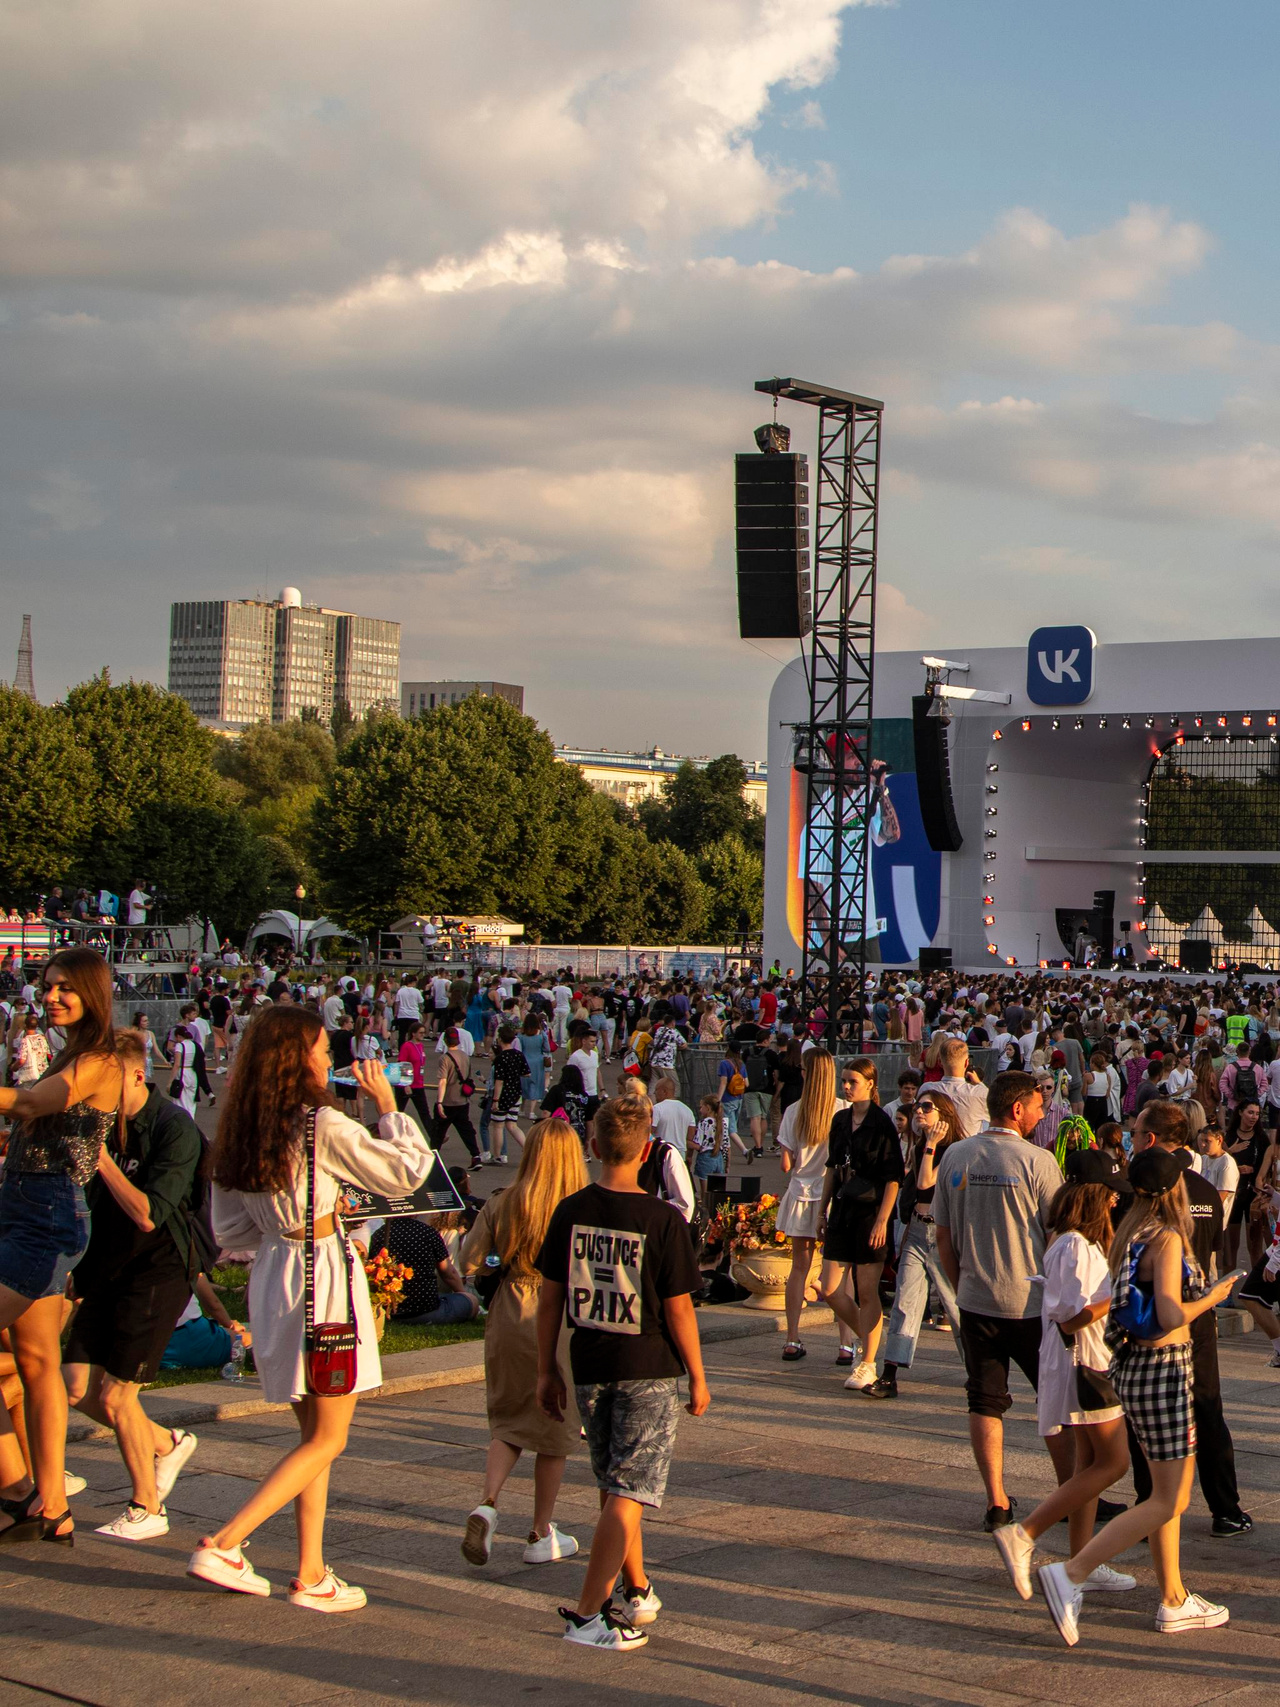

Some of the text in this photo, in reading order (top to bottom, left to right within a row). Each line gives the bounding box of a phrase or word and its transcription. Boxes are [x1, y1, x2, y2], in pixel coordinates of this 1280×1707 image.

[1037, 648, 1081, 684] VK
[574, 1232, 640, 1269] JUSTICE
[574, 1287, 637, 1324] PAIX
